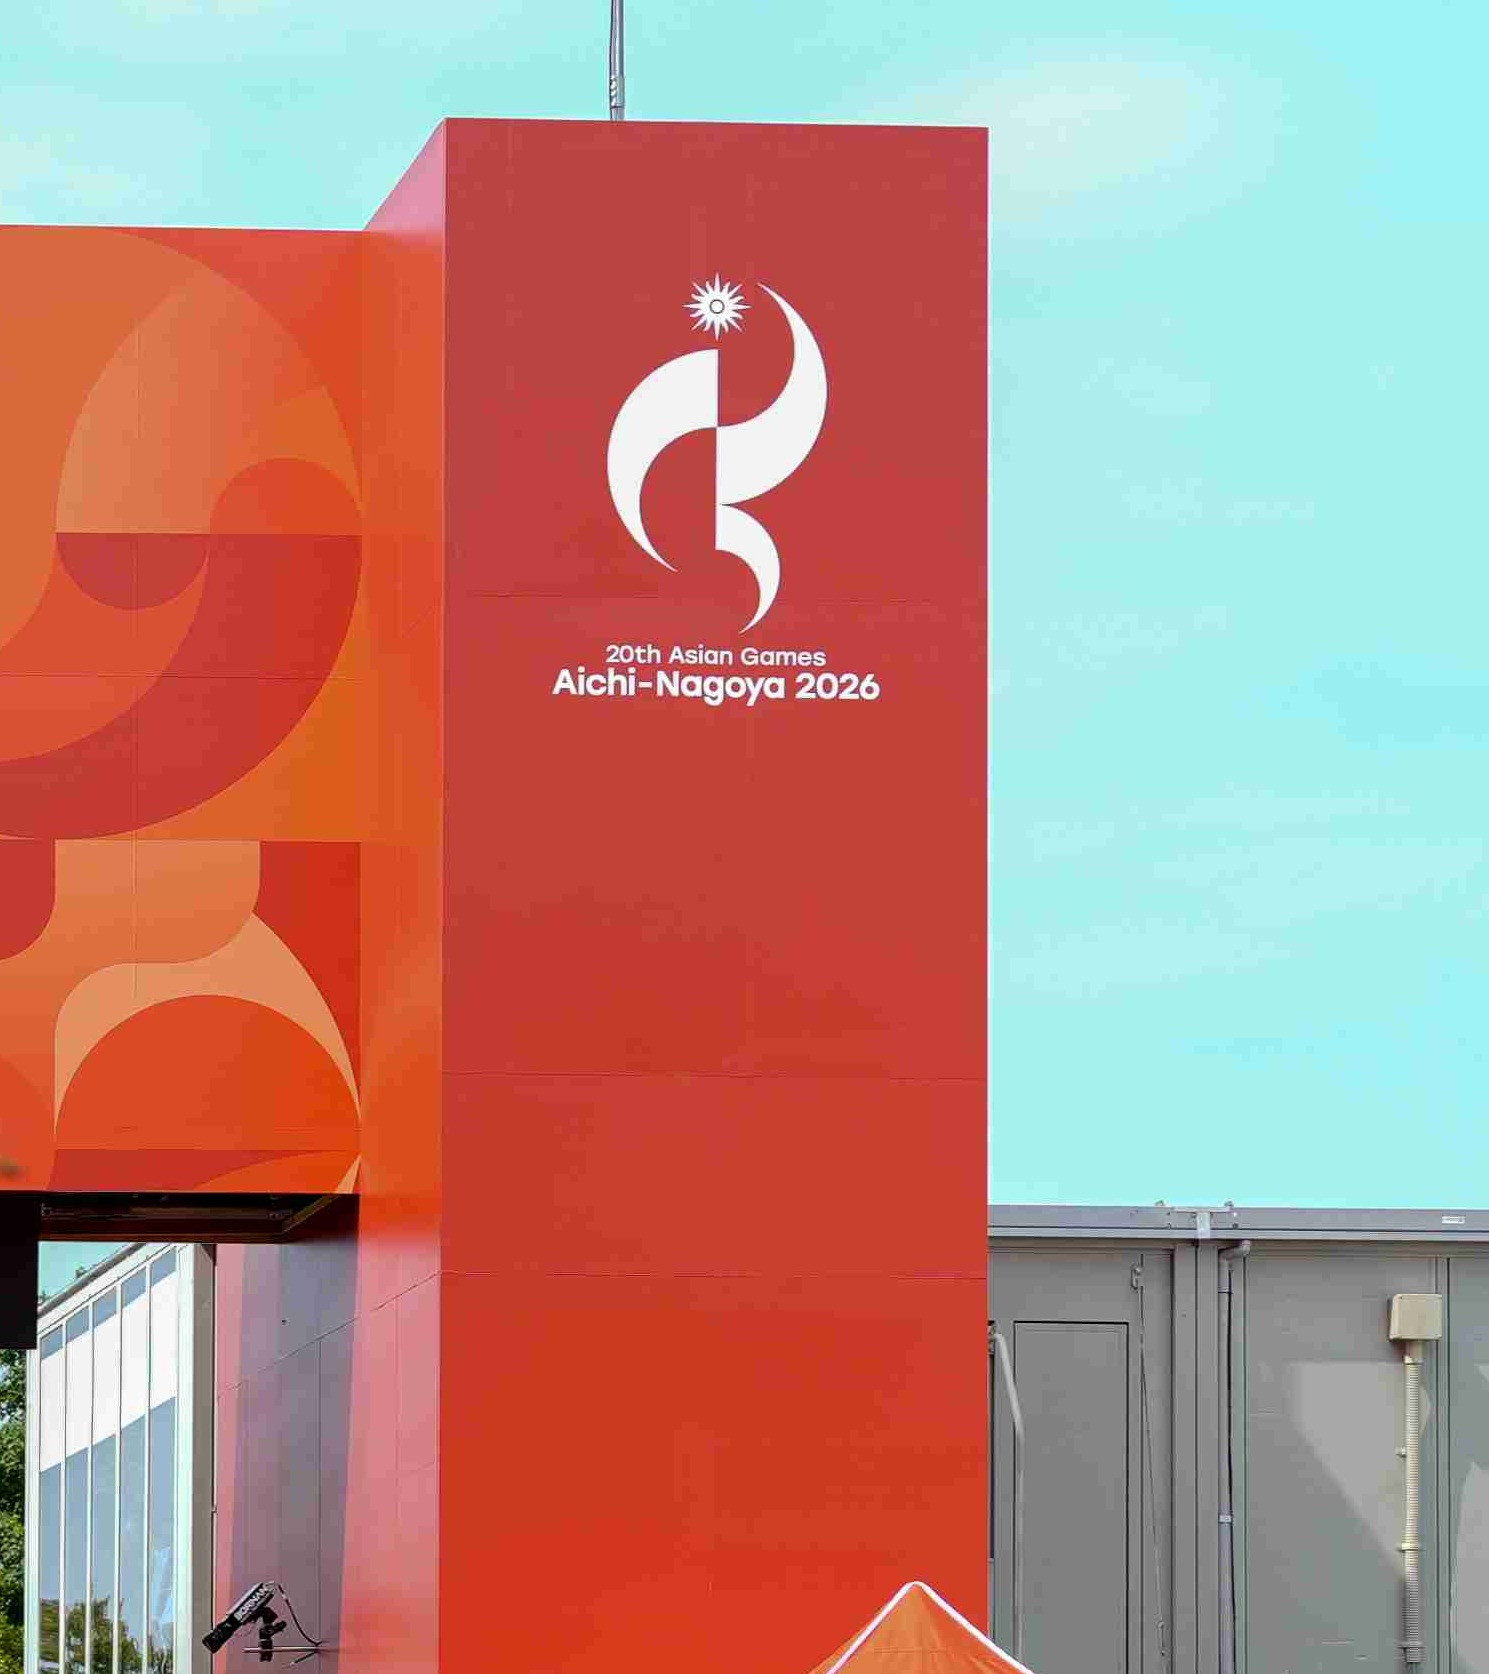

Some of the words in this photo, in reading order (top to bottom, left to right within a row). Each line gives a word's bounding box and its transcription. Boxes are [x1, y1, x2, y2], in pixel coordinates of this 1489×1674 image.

[606, 645, 661, 664] 20th
[669, 645, 733, 665] Asian
[741, 648, 826, 667] Games
[552, 667, 785, 707] Aichi-Nagoya
[795, 673, 881, 701] 2026
